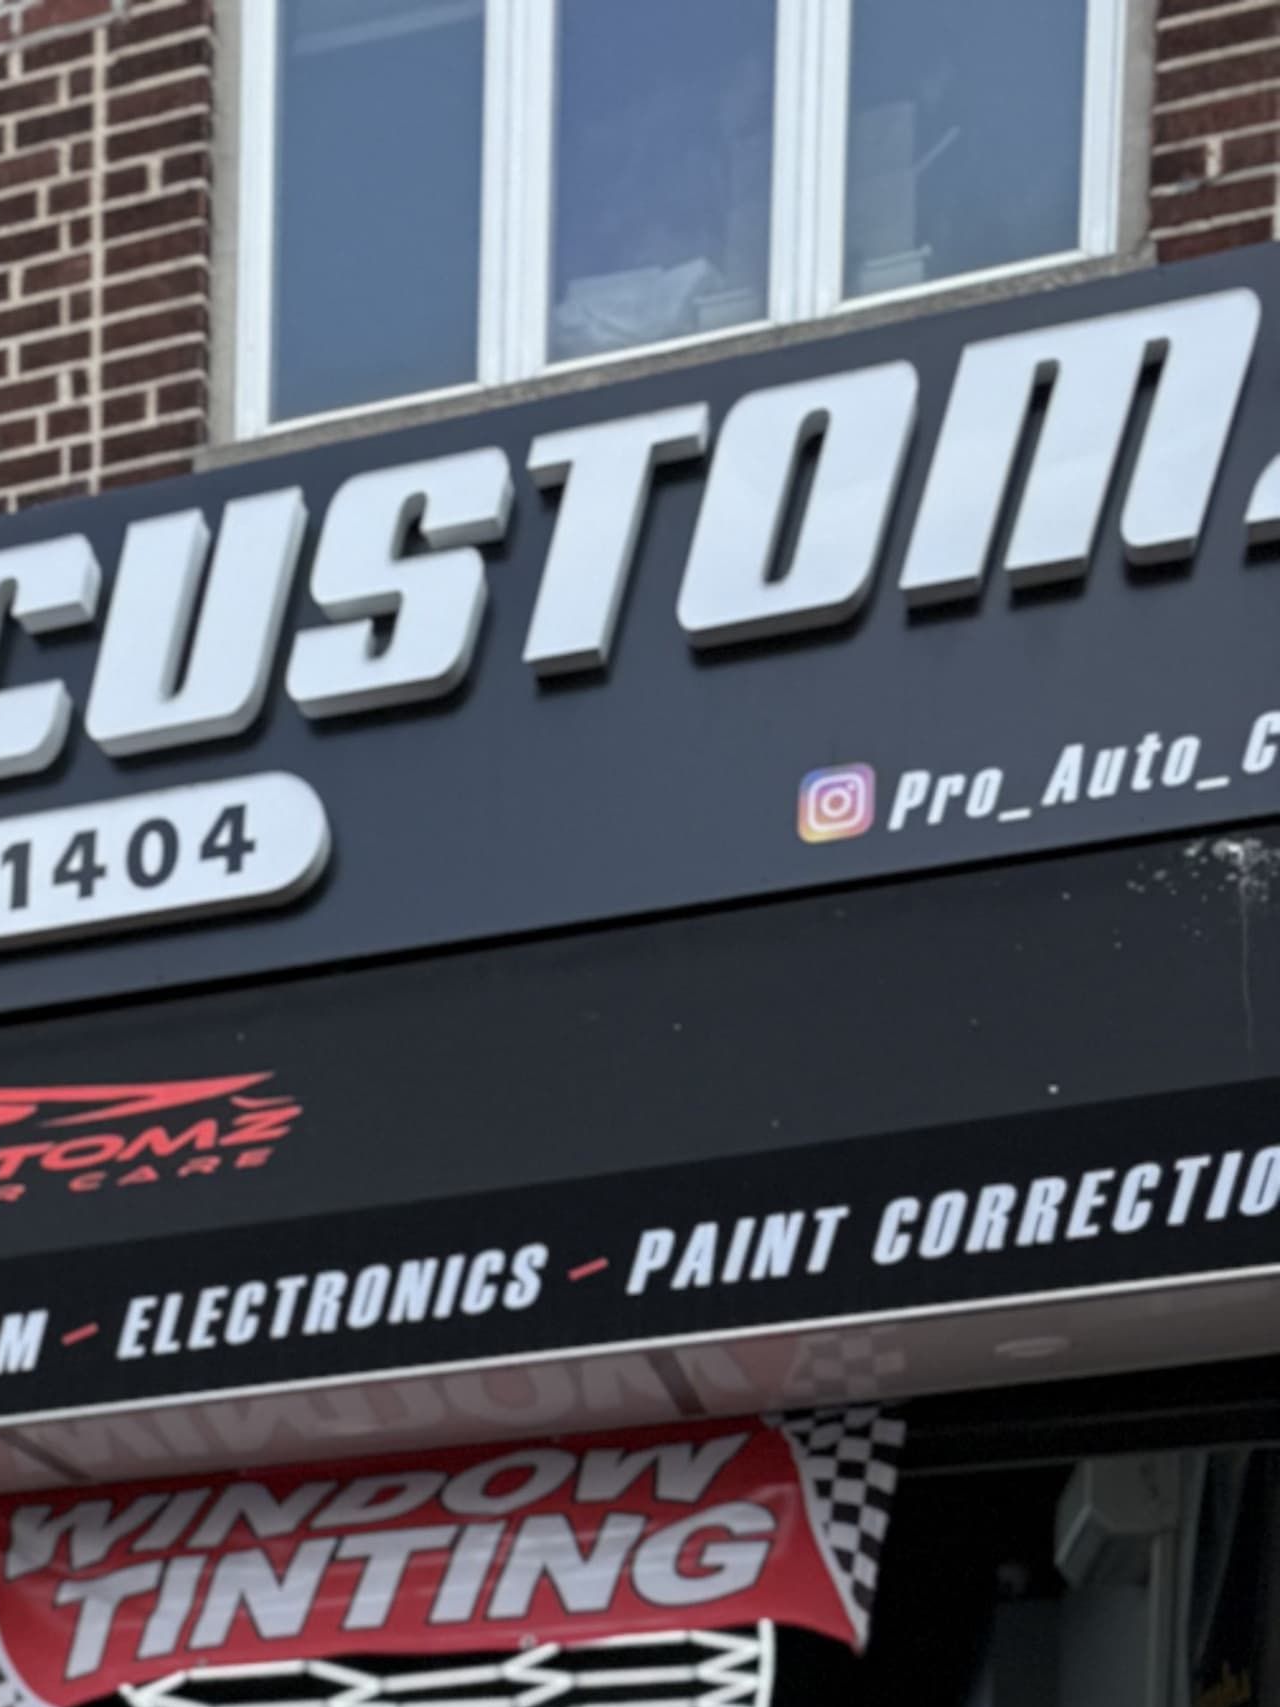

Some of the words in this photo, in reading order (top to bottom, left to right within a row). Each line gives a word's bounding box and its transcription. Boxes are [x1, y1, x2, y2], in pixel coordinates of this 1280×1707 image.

[68, 1147, 276, 1194] CARE
[116, 1244, 550, 1360] ELECTRONICS
[626, 1207, 849, 1296] PAINT
[872, 1145, 1280, 1266] CORRECTIO
[3, 1430, 751, 1580] WINDOW
[54, 1502, 780, 1685] TINTING
